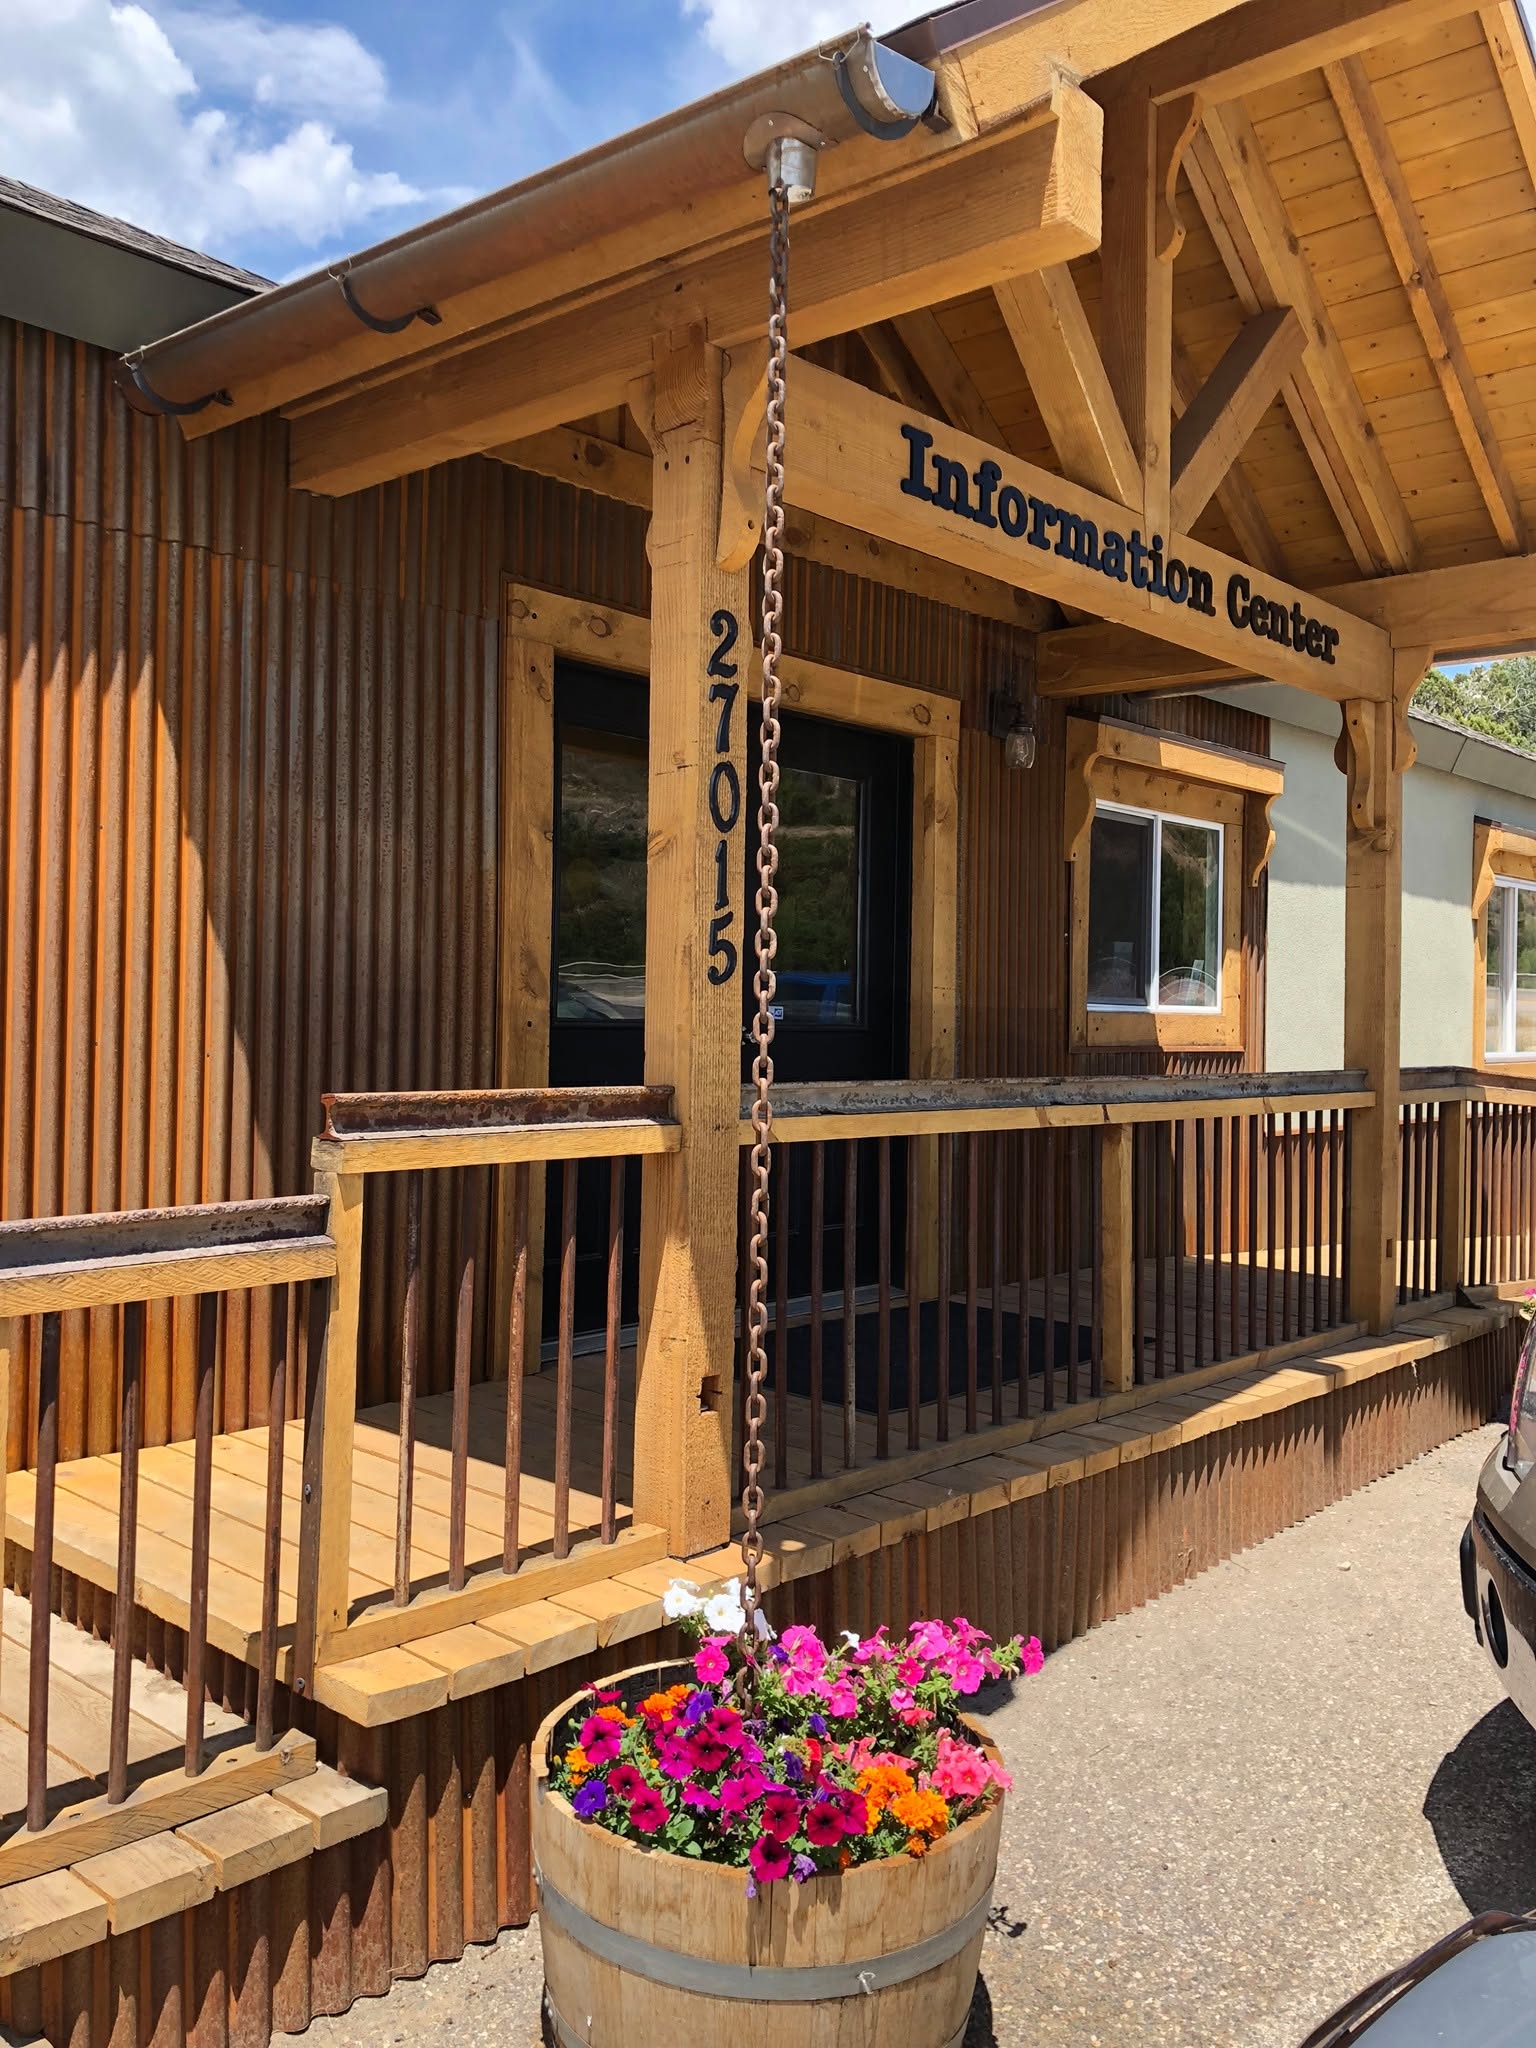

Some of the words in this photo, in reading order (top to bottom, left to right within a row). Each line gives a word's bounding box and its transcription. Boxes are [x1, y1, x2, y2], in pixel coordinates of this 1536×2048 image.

[900, 423, 1216, 616] Information
[1226, 573, 1340, 664] Center
[707, 609, 740, 986] 27015
